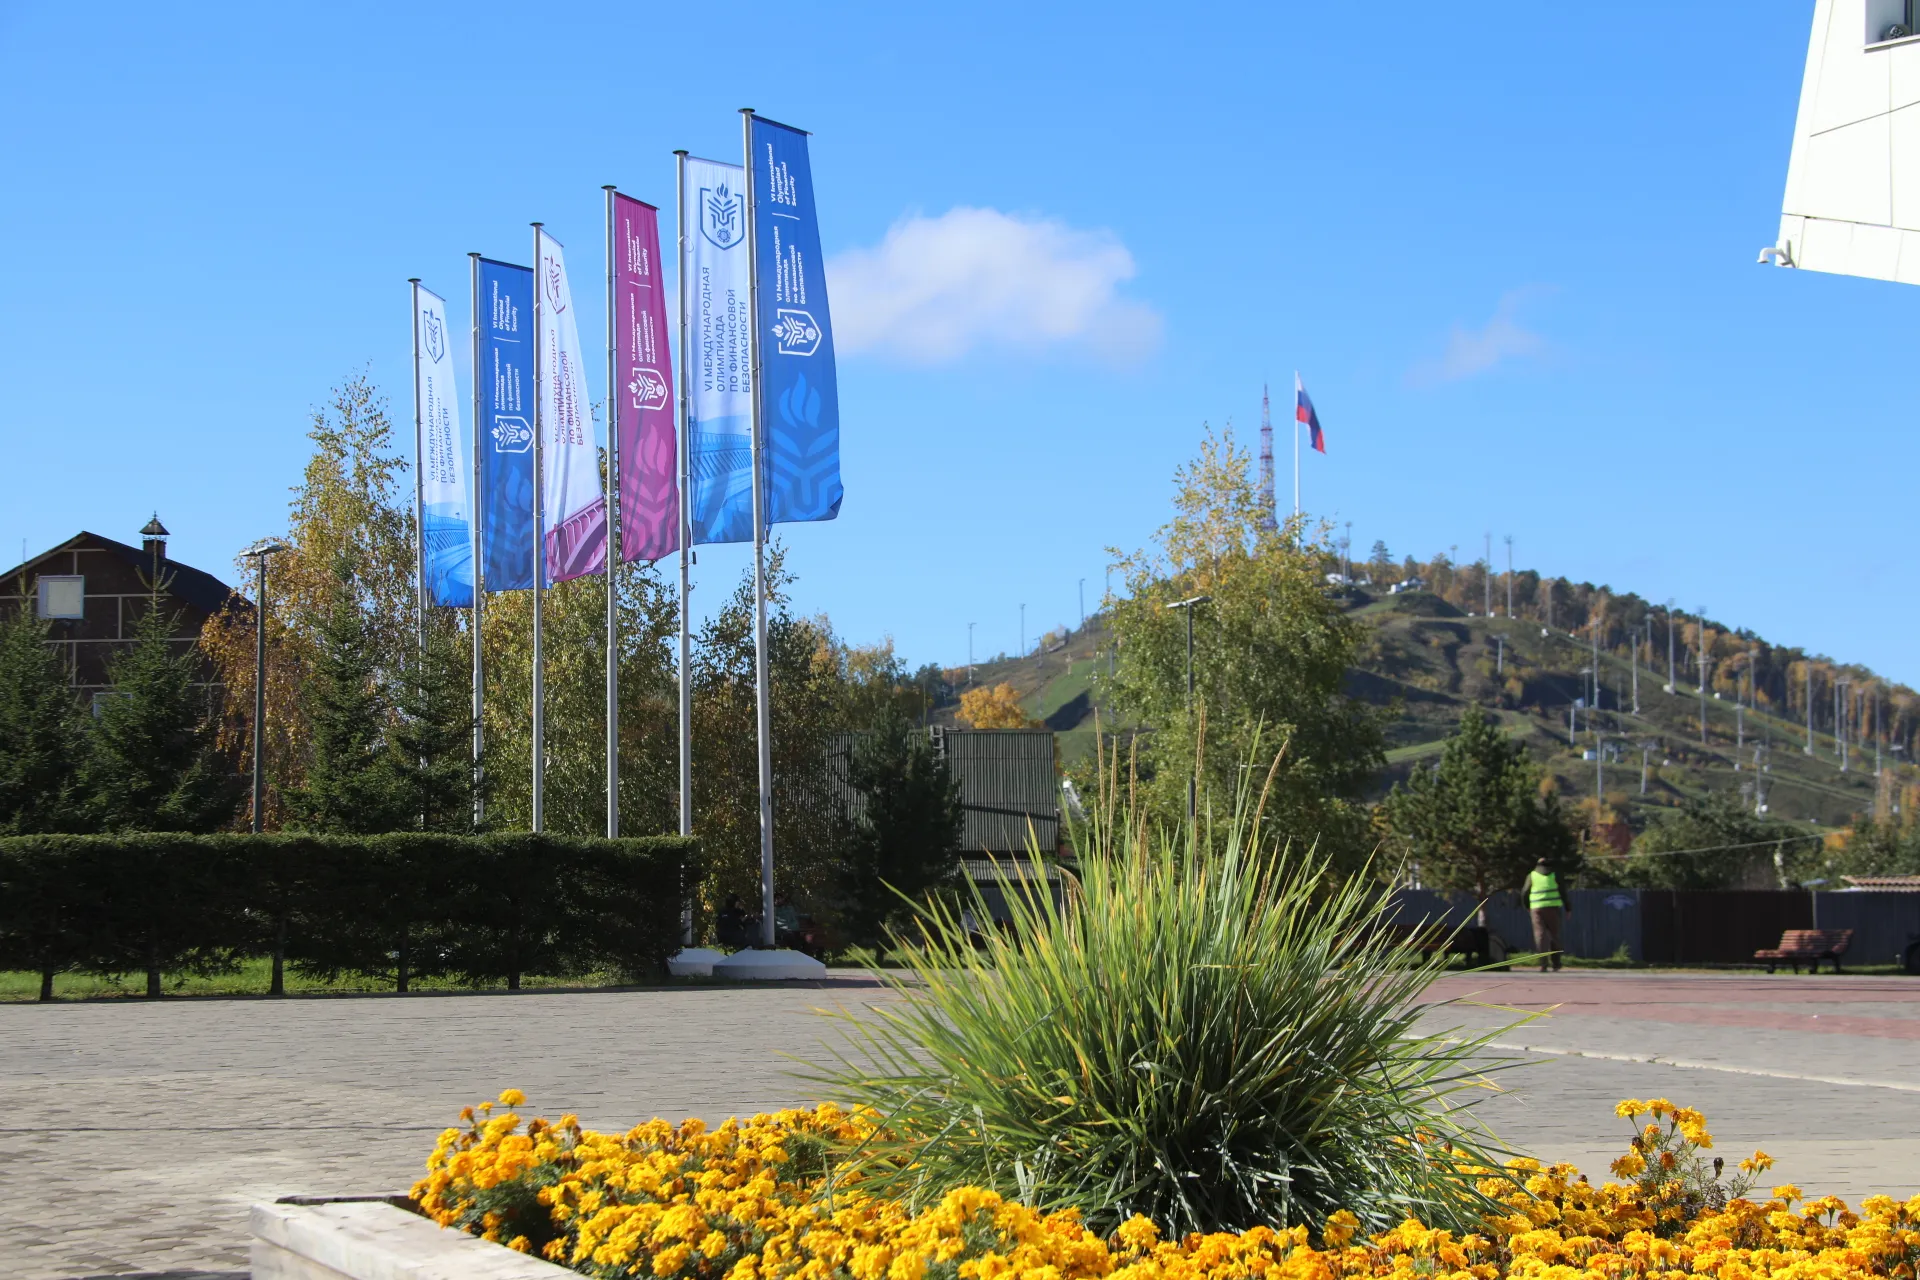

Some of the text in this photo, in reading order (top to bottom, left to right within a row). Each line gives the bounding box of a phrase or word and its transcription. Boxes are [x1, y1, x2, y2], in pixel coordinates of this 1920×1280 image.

[766, 143, 776, 202] VI International
[775, 167, 784, 204] Olympiad
[785, 197, 791, 205] of
[773, 226, 783, 301] VI Международная
[783, 259, 791, 302] олимпиада
[789, 244, 799, 303] по финансовой
[797, 252, 806, 304] безопасности
[641, 310, 651, 362] по финансовой
[702, 266, 713, 392] VI МЕЖДУНАРОДНАЯ
[715, 315, 726, 392] ОЛИМПИАДА
[726, 289, 738, 392] ПО ФИНАНСОВОЙ
[739, 301, 751, 393] БЕЗОПАСНОСТИ
[505, 363, 513, 410] по финансовой
[560, 350, 575, 445] ПО ФИНАНСОВОЙ
[427, 376, 436, 468] МЕЖДУНАРОДНАЯ
[442, 408, 456, 484] БЕЗОПАСНОСТИ
[440, 469, 447, 483] ПО
